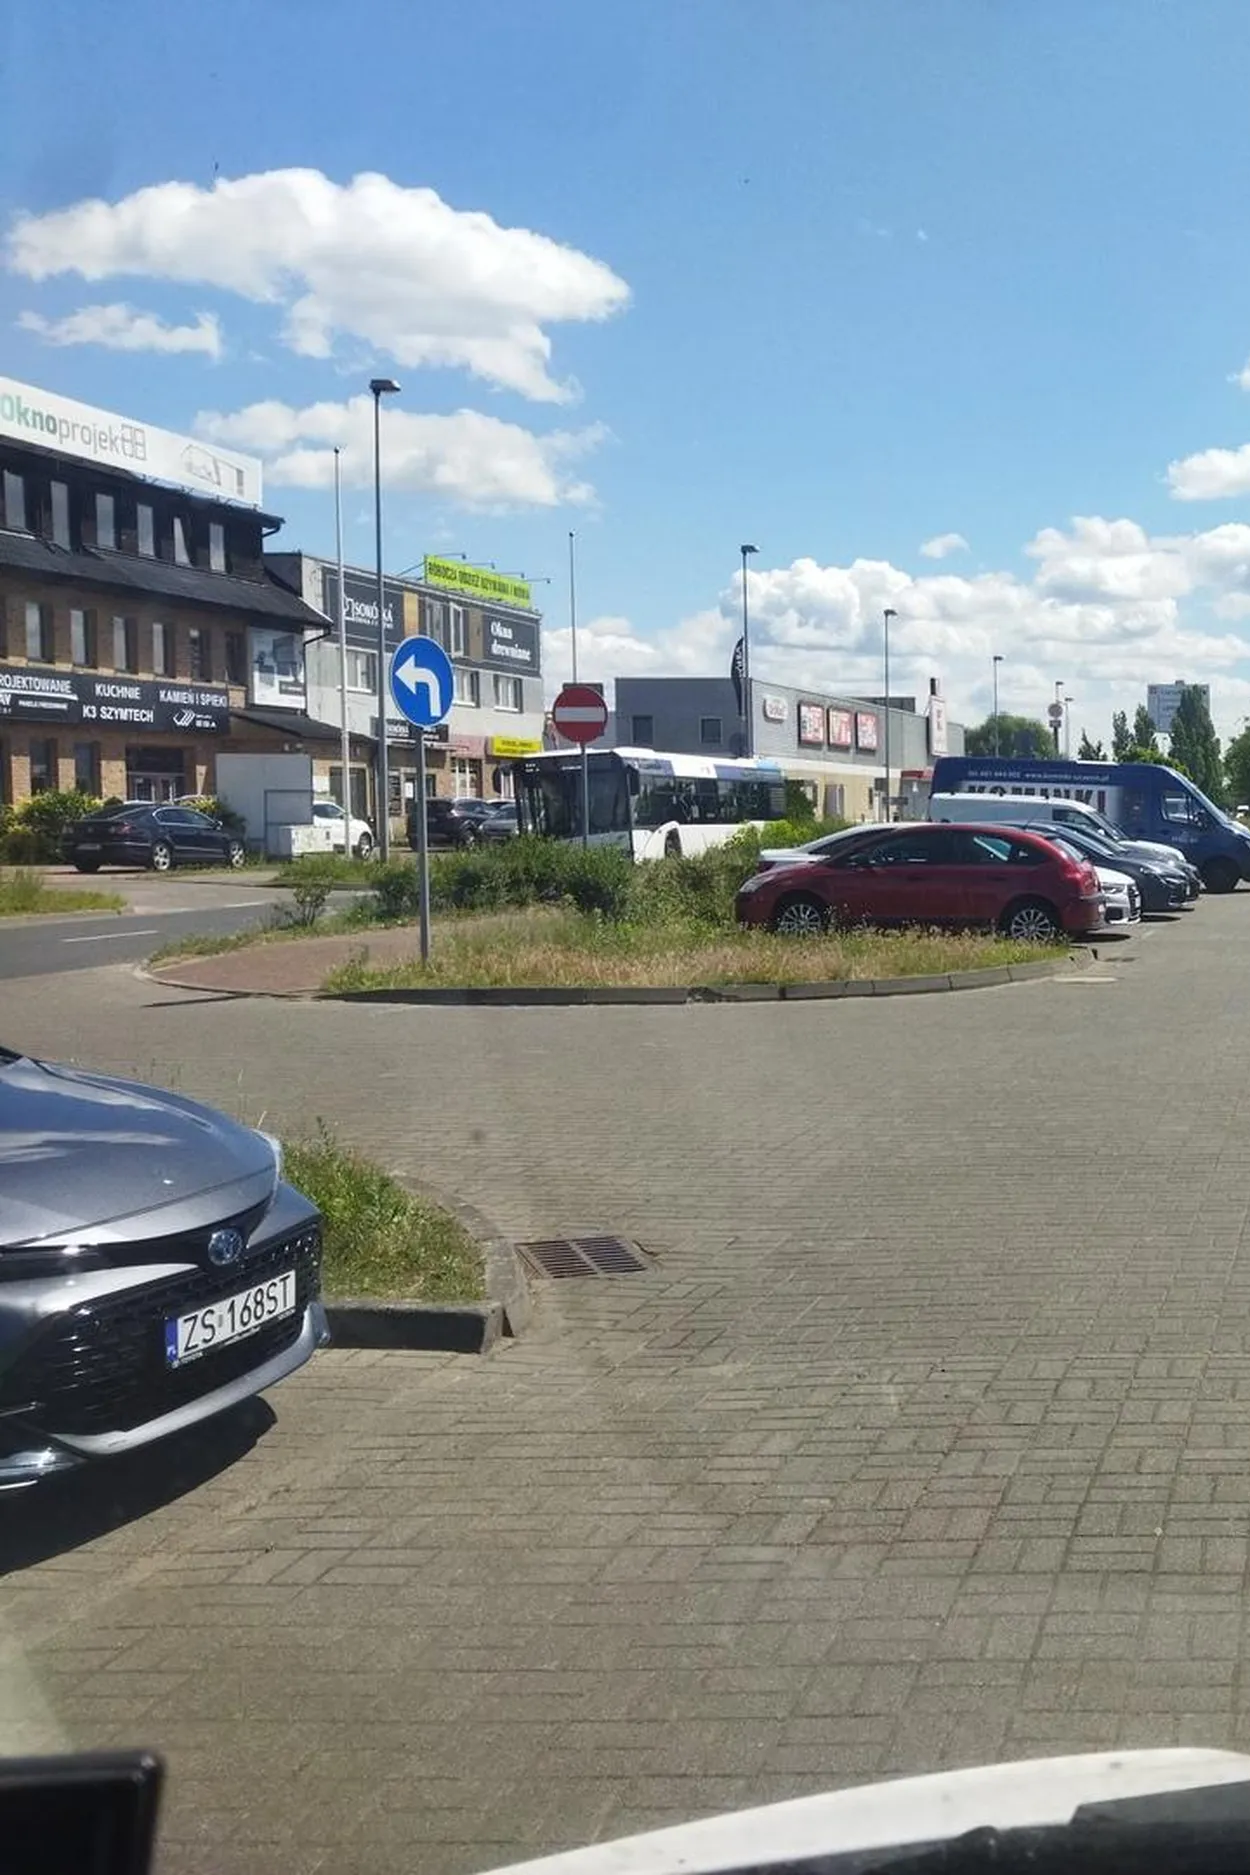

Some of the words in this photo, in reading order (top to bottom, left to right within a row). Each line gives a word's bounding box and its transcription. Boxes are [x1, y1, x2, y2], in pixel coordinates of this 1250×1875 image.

[491, 621, 513, 639] Okna
[491, 639, 531, 661] drewniane
[95, 683, 141, 700] KUCHNIE
[159, 688, 194, 705] KAMIEŃ
[83, 705, 97, 718] K3
[100, 706, 154, 723] SZYMTECH
[183, 1308, 216, 1353] ZS
[227, 1274, 291, 1333] 168ST
